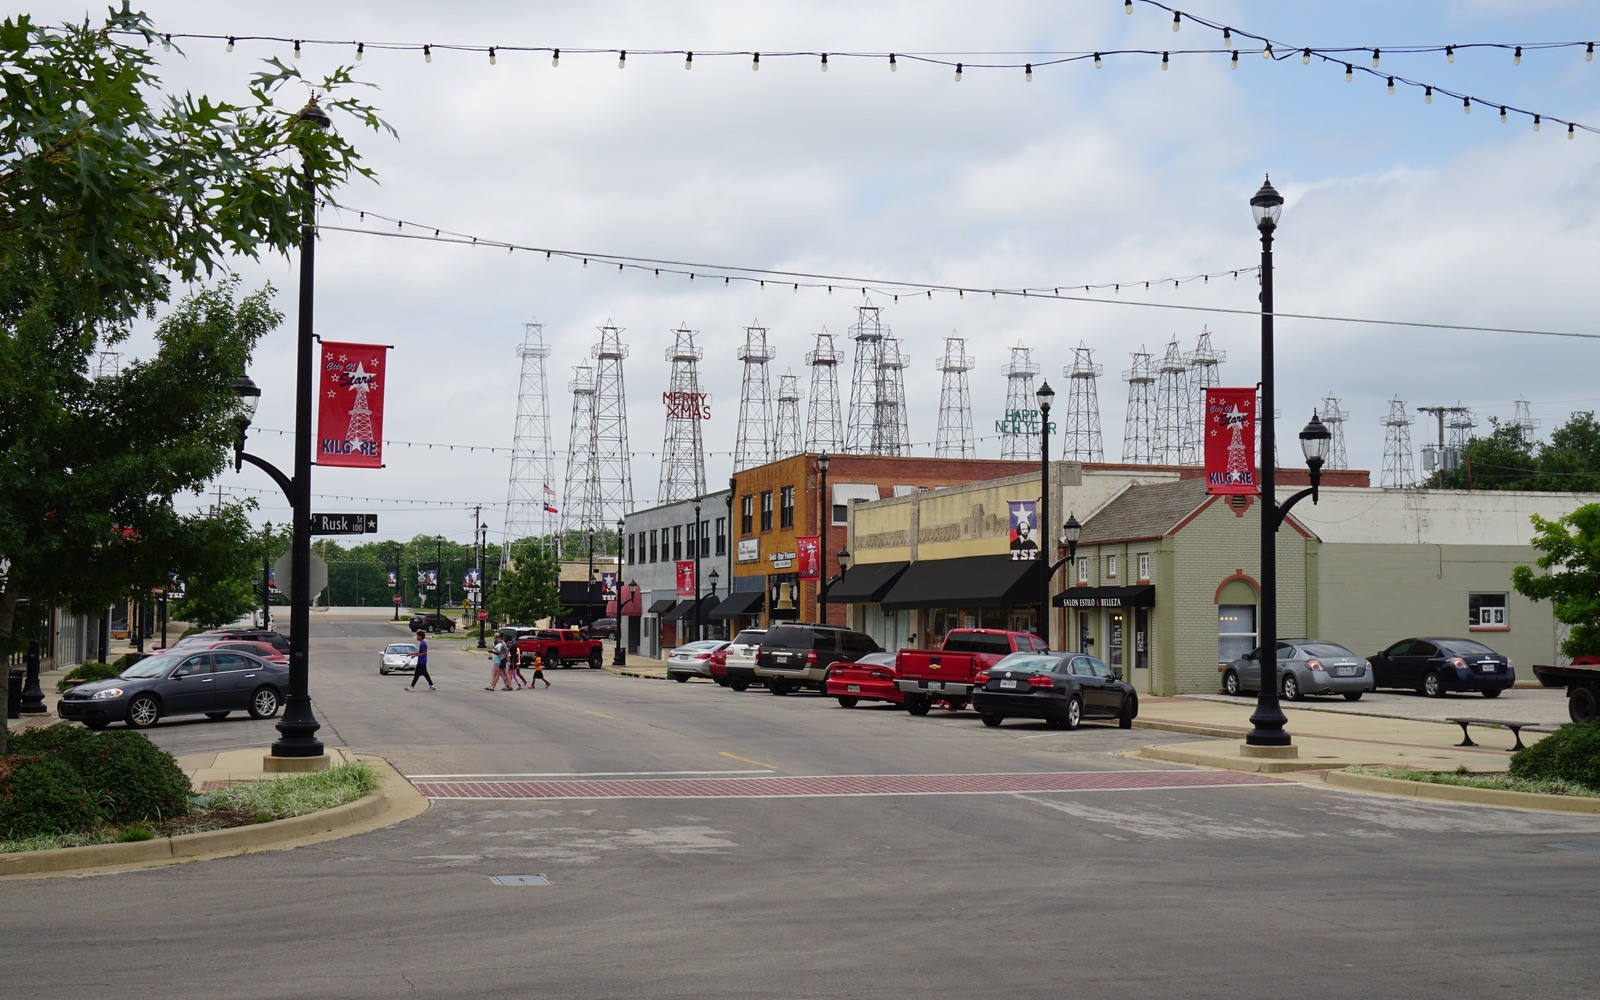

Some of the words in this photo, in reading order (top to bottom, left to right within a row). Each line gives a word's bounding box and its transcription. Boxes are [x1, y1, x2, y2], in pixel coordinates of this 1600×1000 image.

[325, 361, 343, 371] City
[346, 361, 356, 372] Of
[339, 372, 373, 387] Stars
[663, 391, 707, 406] MERRY
[667, 404, 711, 420] XMAS
[1219, 413, 1245, 427] Stars
[995, 420, 1020, 433] NEW
[1024, 421, 1057, 435] YER
[322, 439, 378, 456] KILGRE
[1210, 472, 1253, 485] KILGRE
[313, 514, 317, 523] S
[322, 515, 348, 531] Rusk
[356, 515, 363, 524] St
[352, 523, 363, 532] 100
[1010, 549, 1038, 560] TSF
[1063, 598, 1079, 607] SALON
[1080, 598, 1095, 607] ESTILO
[1101, 598, 1121, 607] BELLEZA
